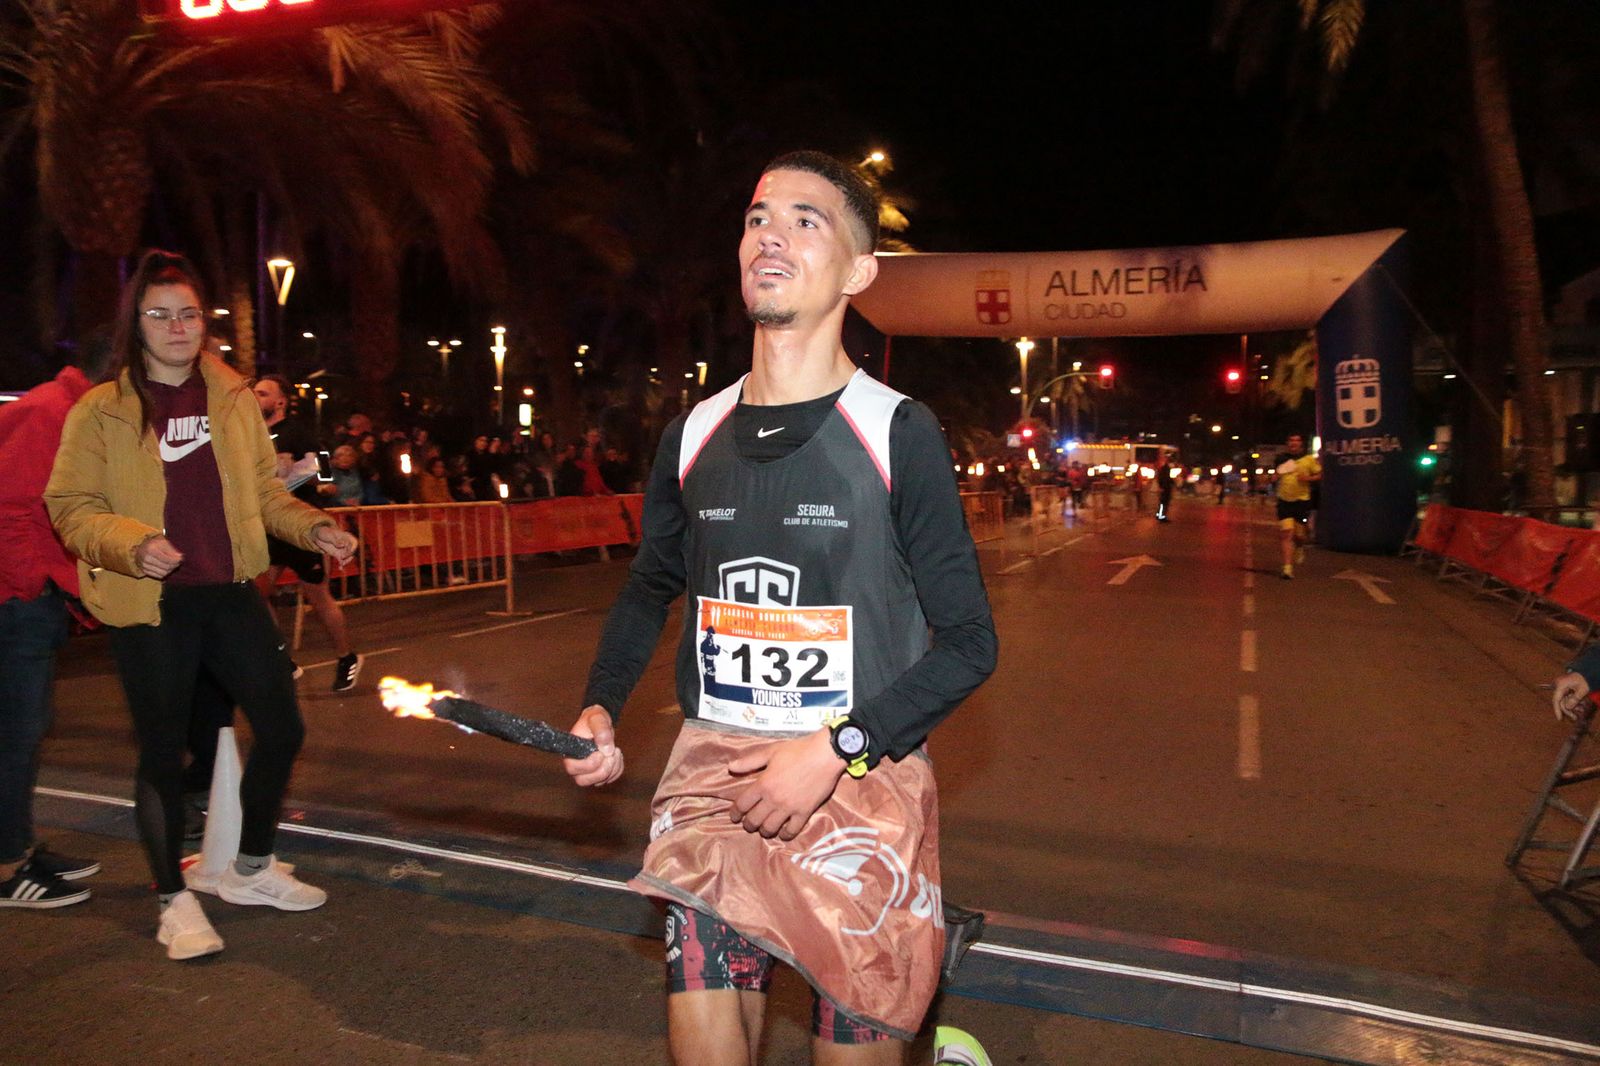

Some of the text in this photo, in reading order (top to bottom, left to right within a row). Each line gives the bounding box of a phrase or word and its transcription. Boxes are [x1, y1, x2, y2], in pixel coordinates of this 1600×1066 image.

[1044, 260, 1208, 297] ALMERÍA
[1043, 302, 1127, 320] CIUDAD
[167, 416, 210, 441] NIKE
[797, 504, 835, 517] SEGURA
[801, 517, 811, 526] DE
[731, 643, 829, 688] 132
[752, 688, 802, 708] YOUNESS
